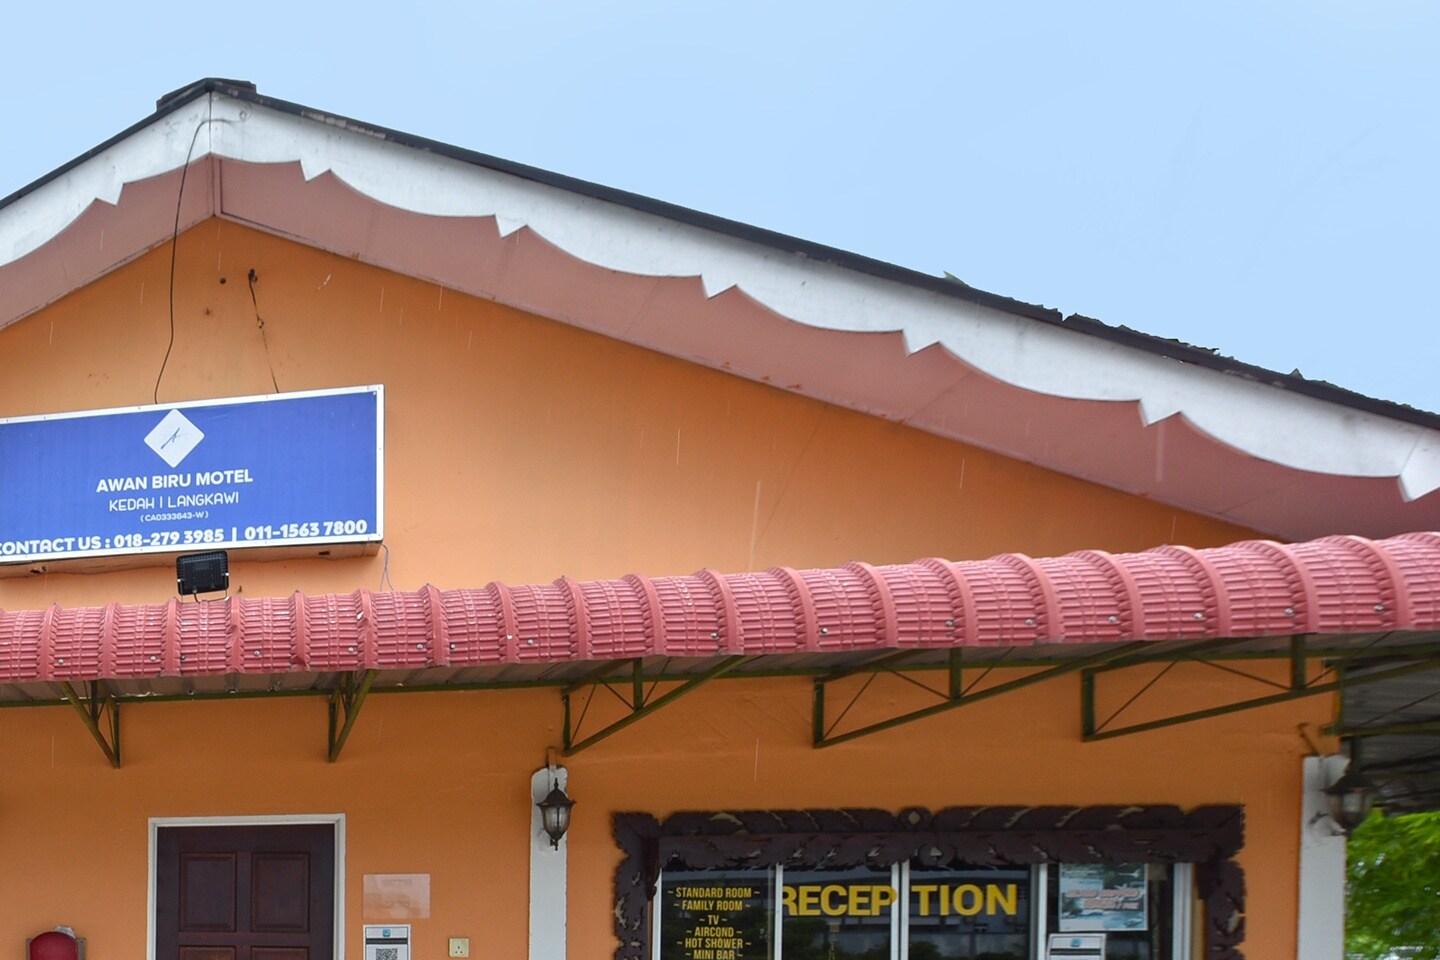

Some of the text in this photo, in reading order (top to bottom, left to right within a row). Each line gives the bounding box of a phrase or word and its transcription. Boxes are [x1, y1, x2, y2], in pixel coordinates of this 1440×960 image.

[96, 469, 254, 493] AWAN BIRU MOTEL
[109, 497, 155, 512] KEDAH
[168, 491, 239, 508] LANGKAWI
[78, 536, 102, 550] US
[113, 531, 180, 548] 018-279
[183, 528, 224, 544] 3985
[244, 522, 320, 540] 011-1563
[323, 519, 367, 535] 7800
[675, 887, 752, 898] STANDARD ROOM
[681, 900, 743, 911] FAMILY ROOM
[707, 914, 720, 925] TV
[694, 926, 734, 937] AIRCOND
[685, 938, 744, 949] HOT SHOWER
[693, 949, 735, 960] MINI BAR
